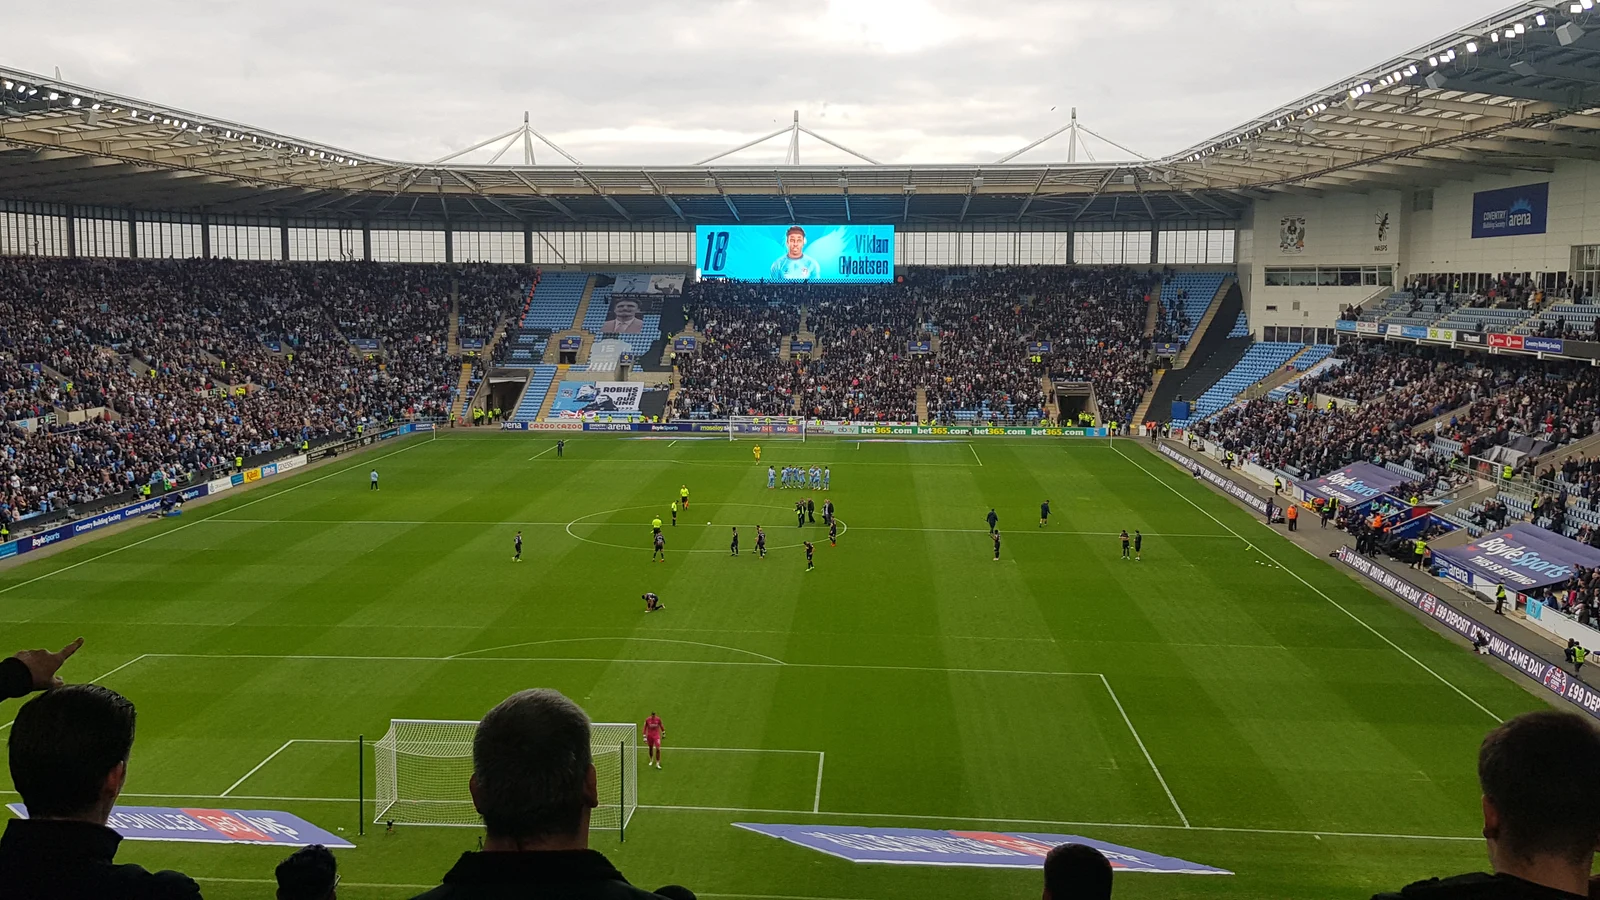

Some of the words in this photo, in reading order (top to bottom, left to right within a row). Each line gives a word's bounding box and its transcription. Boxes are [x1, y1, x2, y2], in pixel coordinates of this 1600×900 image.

[1484, 210, 1506, 220] COVENTRY
[1509, 213, 1531, 226] arena
[704, 232, 729, 270] 18
[917, 426, 969, 434] bet365.com
[1327, 472, 1380, 496] BoyleSports
[125, 507, 140, 516] Coventry
[76, 522, 92, 532] Coventry
[93, 517, 108, 526] Building
[108, 513, 121, 524] Society
[32, 532, 60, 547] BoyleSports
[1478, 538, 1571, 578] BoyleSports
[1345, 552, 1354, 564] £99
[1353, 555, 1371, 573] DEPOSIT
[1370, 566, 1384, 582] DRIVE
[1383, 574, 1398, 589] AWAY
[1396, 581, 1410, 597] SAME
[1408, 588, 1422, 604] DAY
[1449, 564, 1468, 583] arena
[1469, 556, 1494, 566] THIS
[1494, 568, 1536, 584] BETTING
[1435, 604, 1447, 619] £99
[1446, 610, 1471, 633] DEPOSIT
[1488, 636, 1509, 657] AWAY
[1508, 647, 1528, 669] SAME
[1528, 660, 1545, 677] DAY
[1568, 683, 1584, 702] £99
